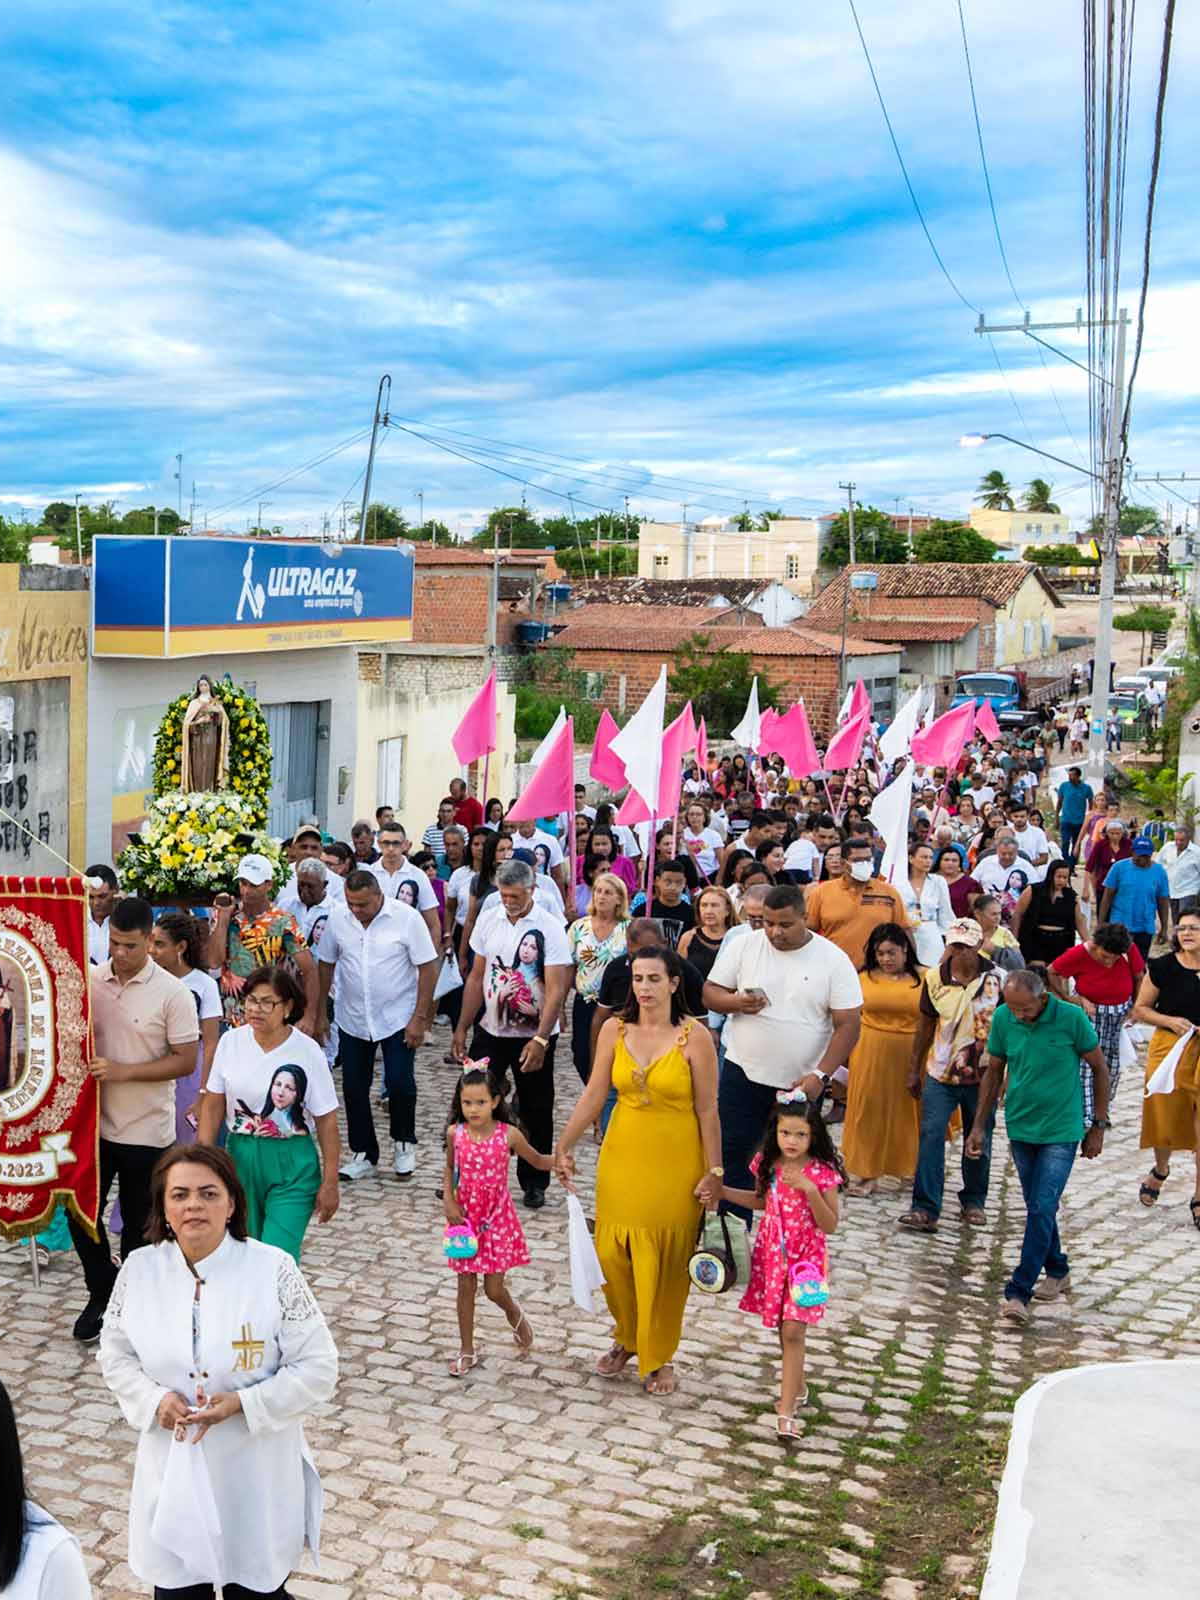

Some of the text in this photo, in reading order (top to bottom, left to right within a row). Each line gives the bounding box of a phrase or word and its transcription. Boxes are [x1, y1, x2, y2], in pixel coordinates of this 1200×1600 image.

[267, 567, 357, 597] ULTRAGAZ
[31, 1015, 45, 1038] DE
[3, 1048, 46, 1113] LISIEUX
